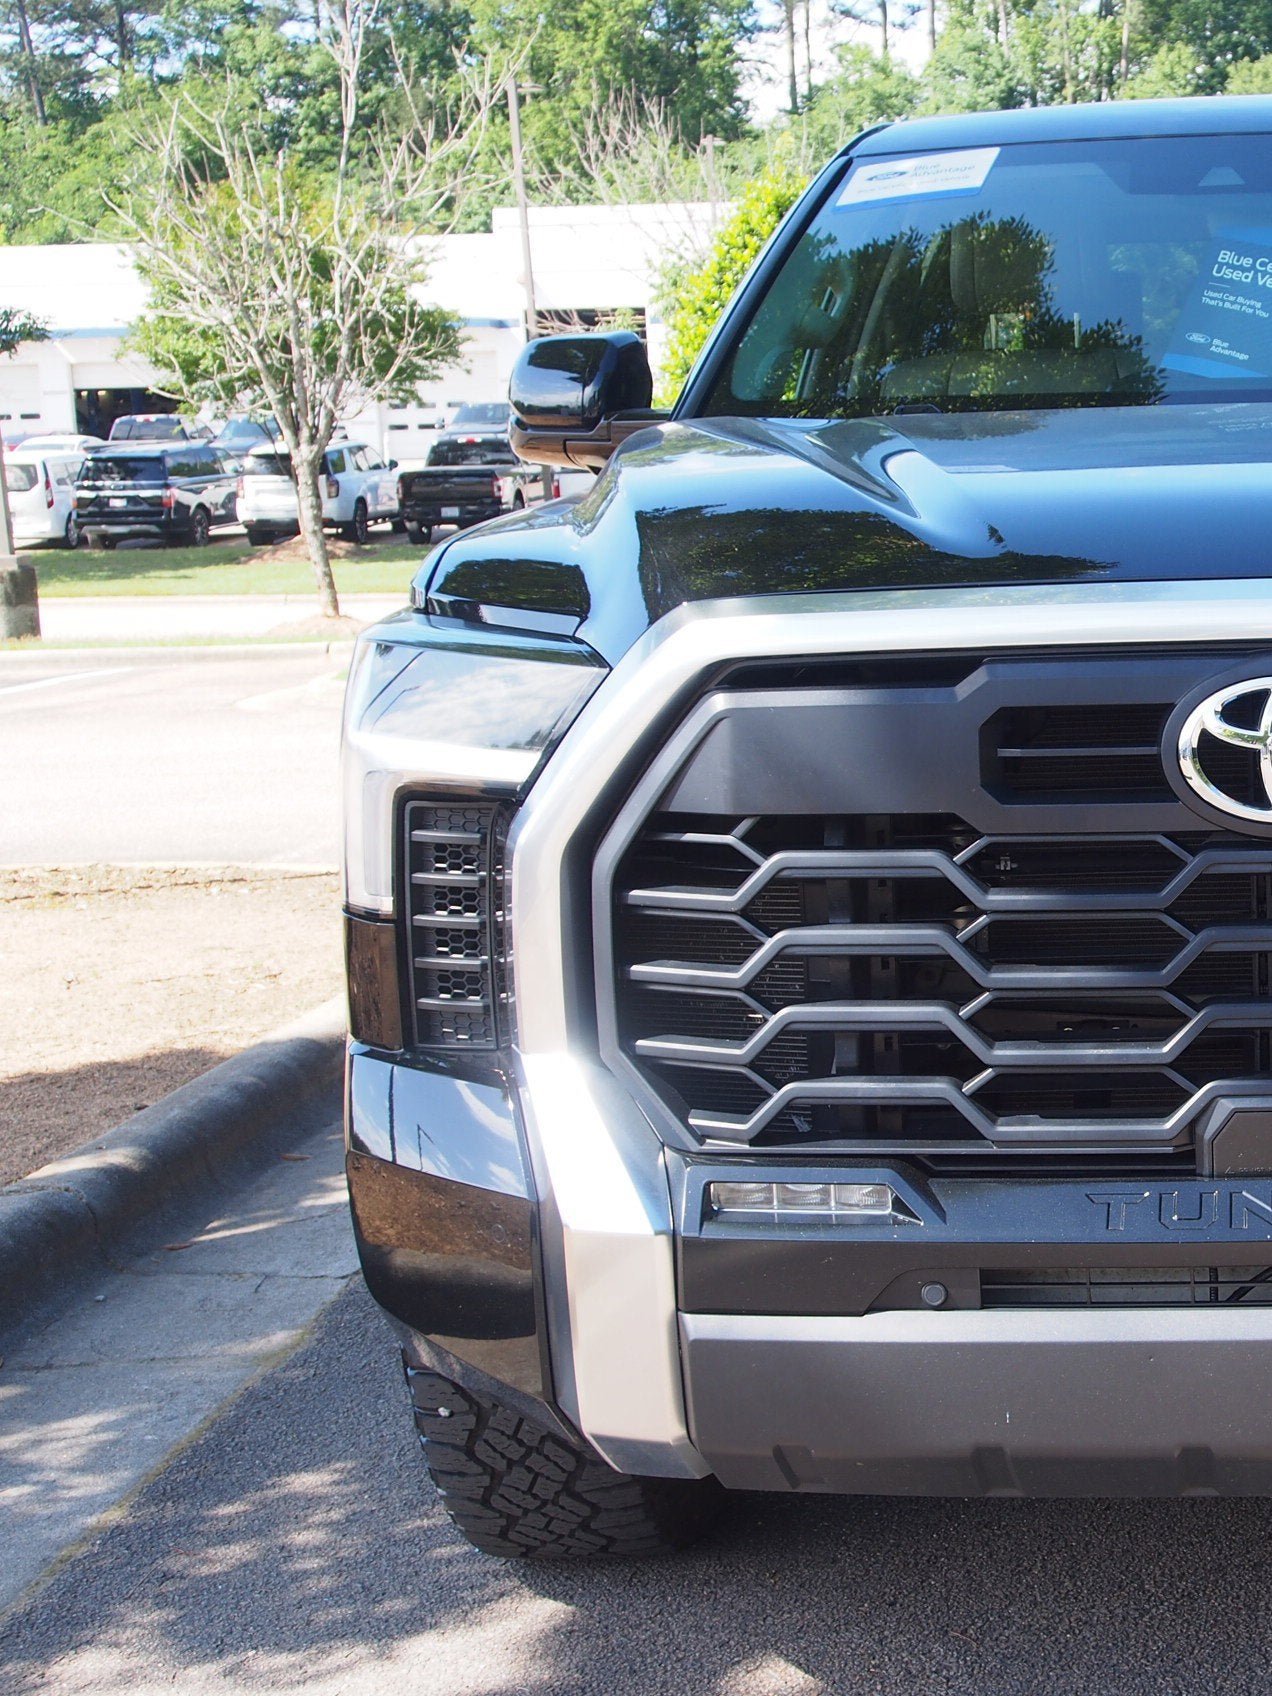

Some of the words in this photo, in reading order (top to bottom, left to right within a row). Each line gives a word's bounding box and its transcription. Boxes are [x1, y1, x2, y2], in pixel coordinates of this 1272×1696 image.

[1217, 249, 1253, 267] Blue
[1212, 263, 1254, 283] Used
[1201, 296, 1223, 307] That's
[1223, 301, 1241, 311] Built
[1241, 305, 1254, 314] For
[1255, 308, 1269, 318] You
[1203, 289, 1223, 299] Used
[1223, 293, 1237, 302] Car
[1236, 295, 1262, 309] Buying
[1212, 338, 1229, 348] Blue
[1210, 345, 1249, 361] Advantage
